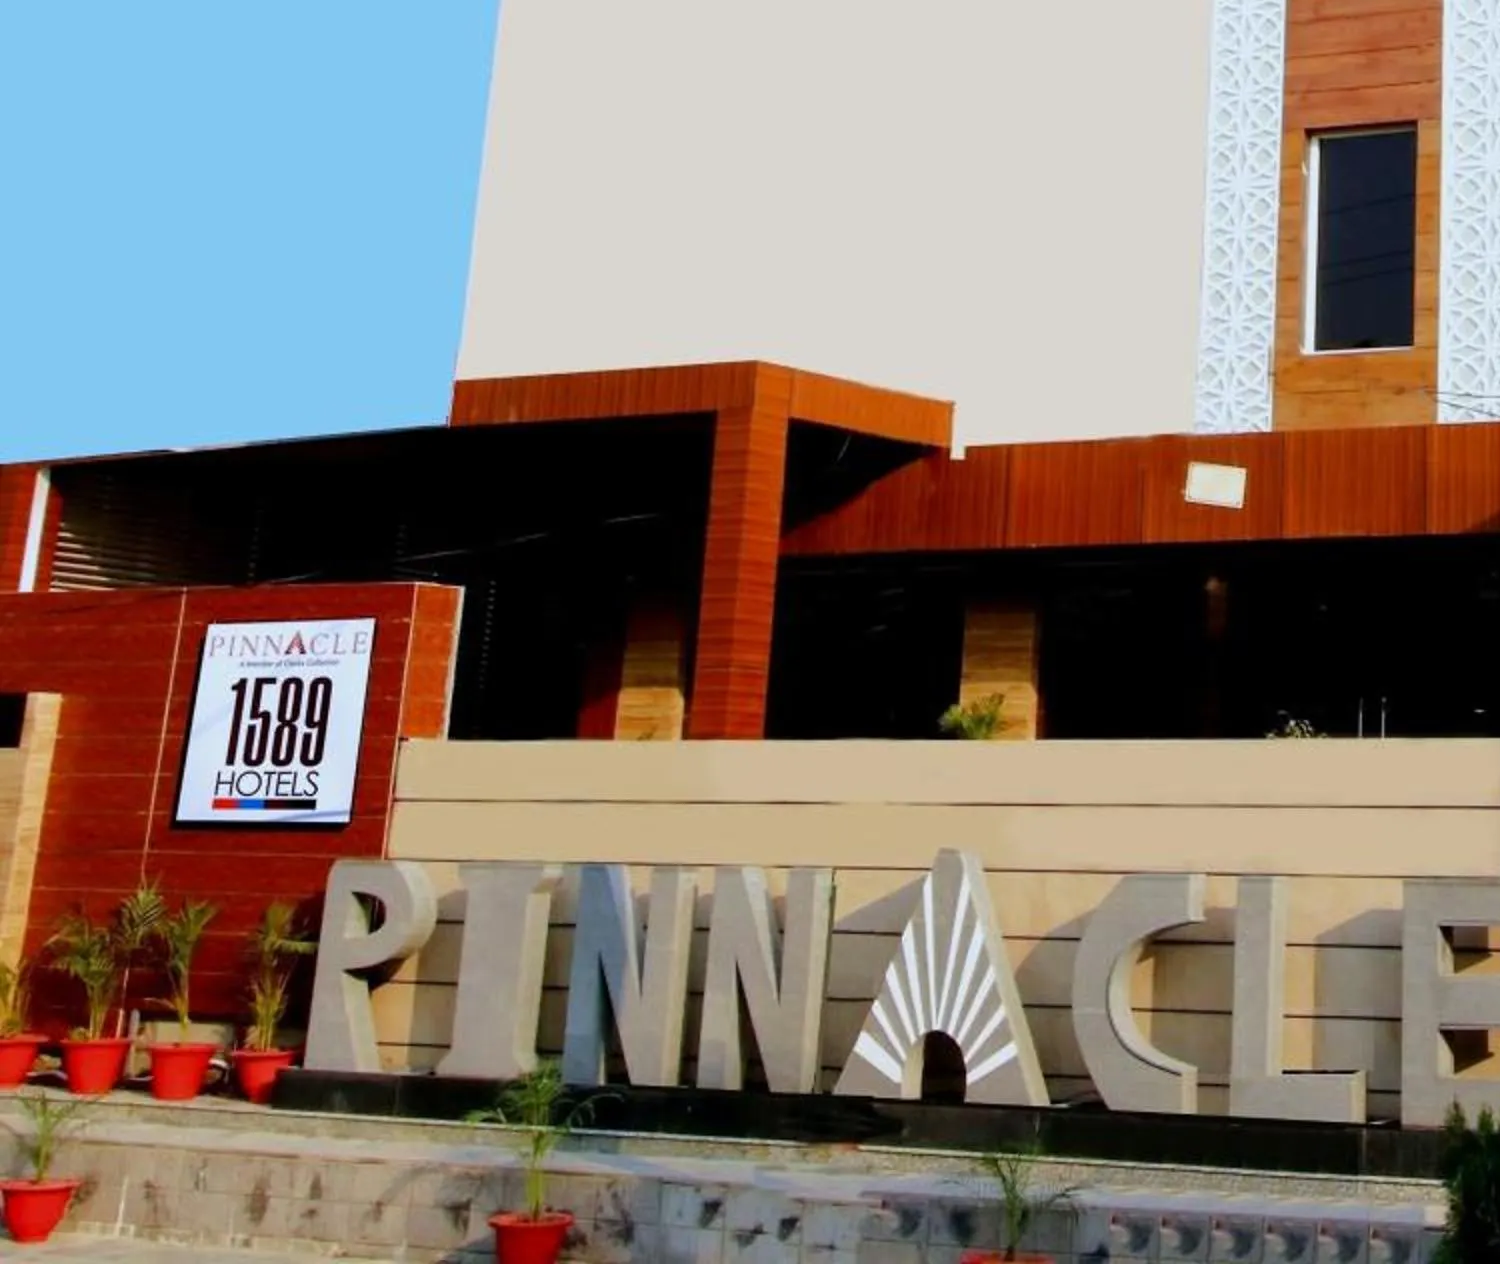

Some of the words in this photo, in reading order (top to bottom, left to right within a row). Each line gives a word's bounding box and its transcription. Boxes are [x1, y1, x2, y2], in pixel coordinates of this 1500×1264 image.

[209, 630, 369, 657] PINNACLE
[225, 676, 333, 767] 1589
[214, 770, 320, 797] HOTELS
